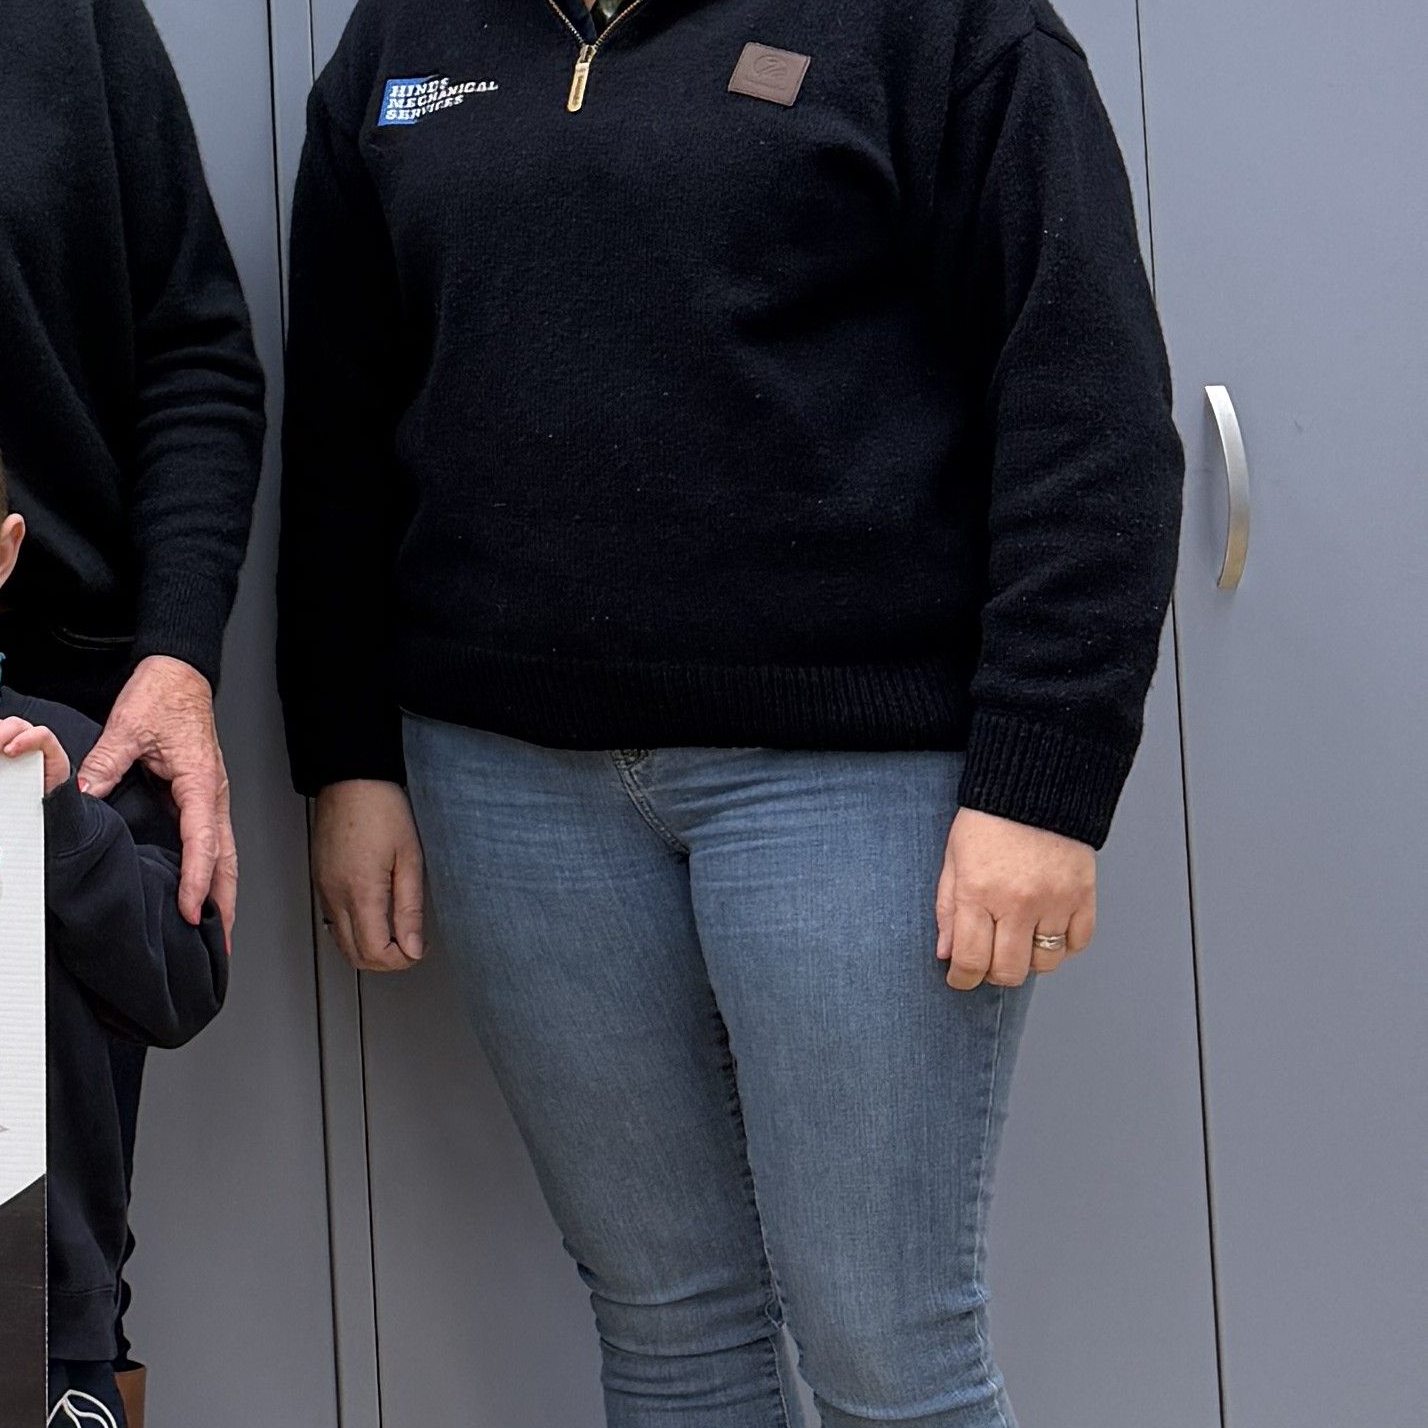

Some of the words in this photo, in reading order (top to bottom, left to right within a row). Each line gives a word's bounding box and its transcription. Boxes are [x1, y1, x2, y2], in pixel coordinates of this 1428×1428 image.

[387, 81, 498, 109] MECHANICAL
[389, 77, 449, 97] HINDS
[385, 94, 464, 120] SERVICES
